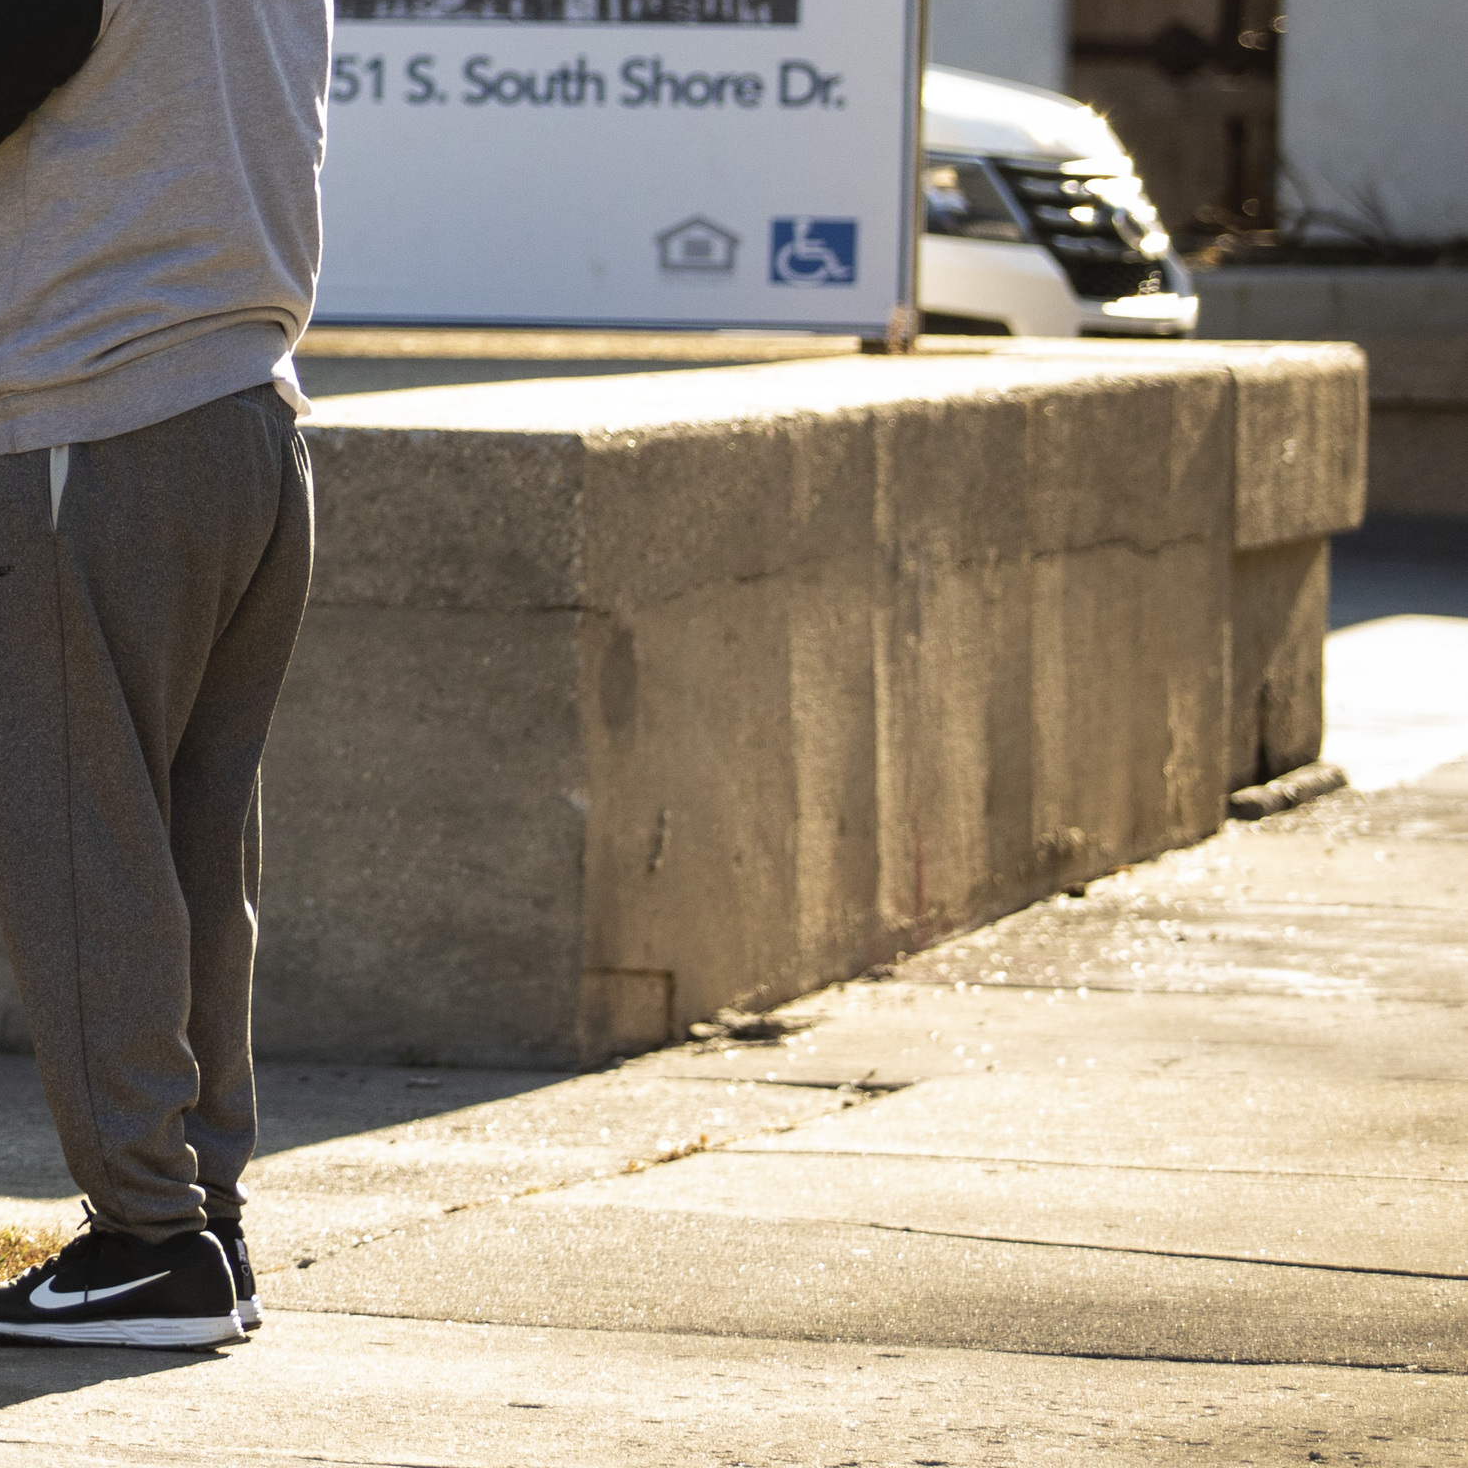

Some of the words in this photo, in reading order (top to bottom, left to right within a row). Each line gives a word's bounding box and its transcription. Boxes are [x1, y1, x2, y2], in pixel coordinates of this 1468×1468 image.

[330, 52, 384, 106] 51
[402, 52, 448, 106] S.
[463, 52, 606, 108] South
[618, 54, 764, 110] Shore
[777, 57, 845, 110] Dr.
